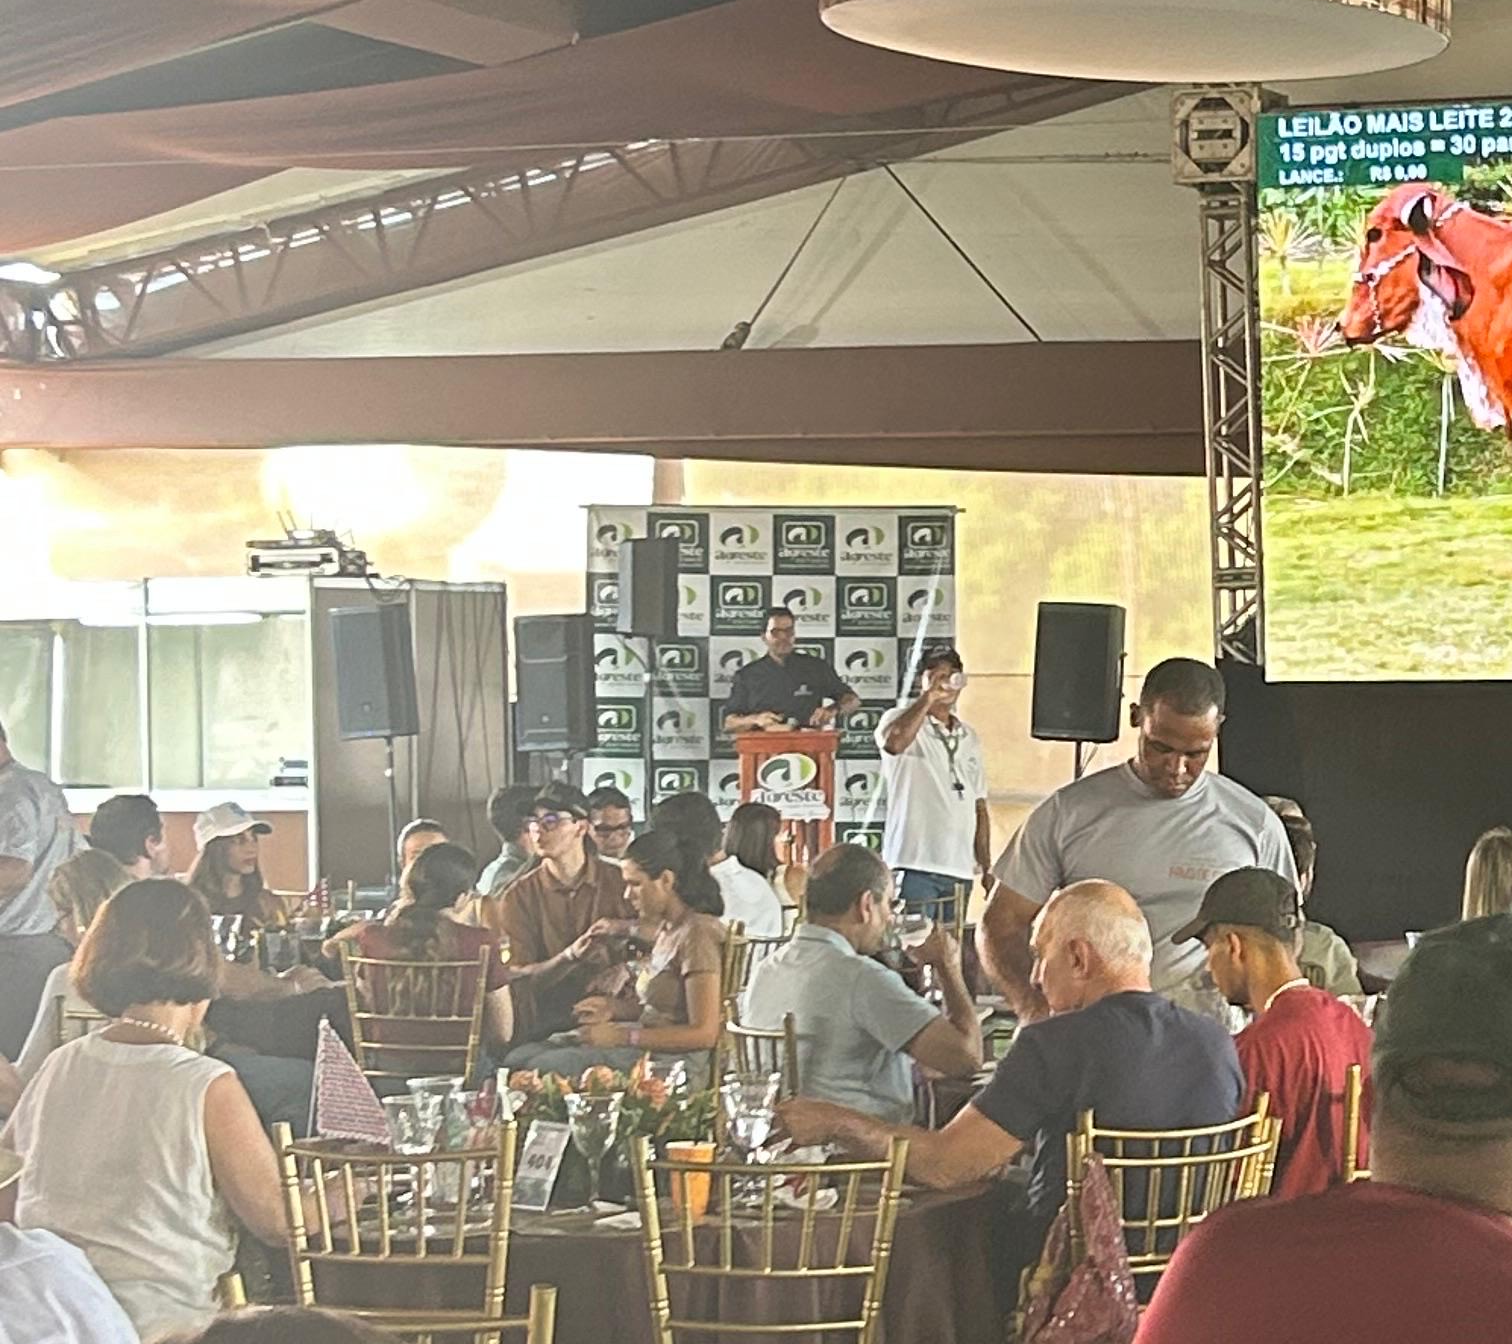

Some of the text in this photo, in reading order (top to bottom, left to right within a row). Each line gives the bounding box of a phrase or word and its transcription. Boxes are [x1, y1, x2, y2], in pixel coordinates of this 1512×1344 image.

[1278, 111, 1362, 139] LEILÃO
[1367, 109, 1424, 135] MAIS
[1429, 107, 1495, 132] LEITE
[1279, 142, 1306, 162] 15
[1351, 137, 1426, 161] duplos
[1450, 135, 1477, 155] 30
